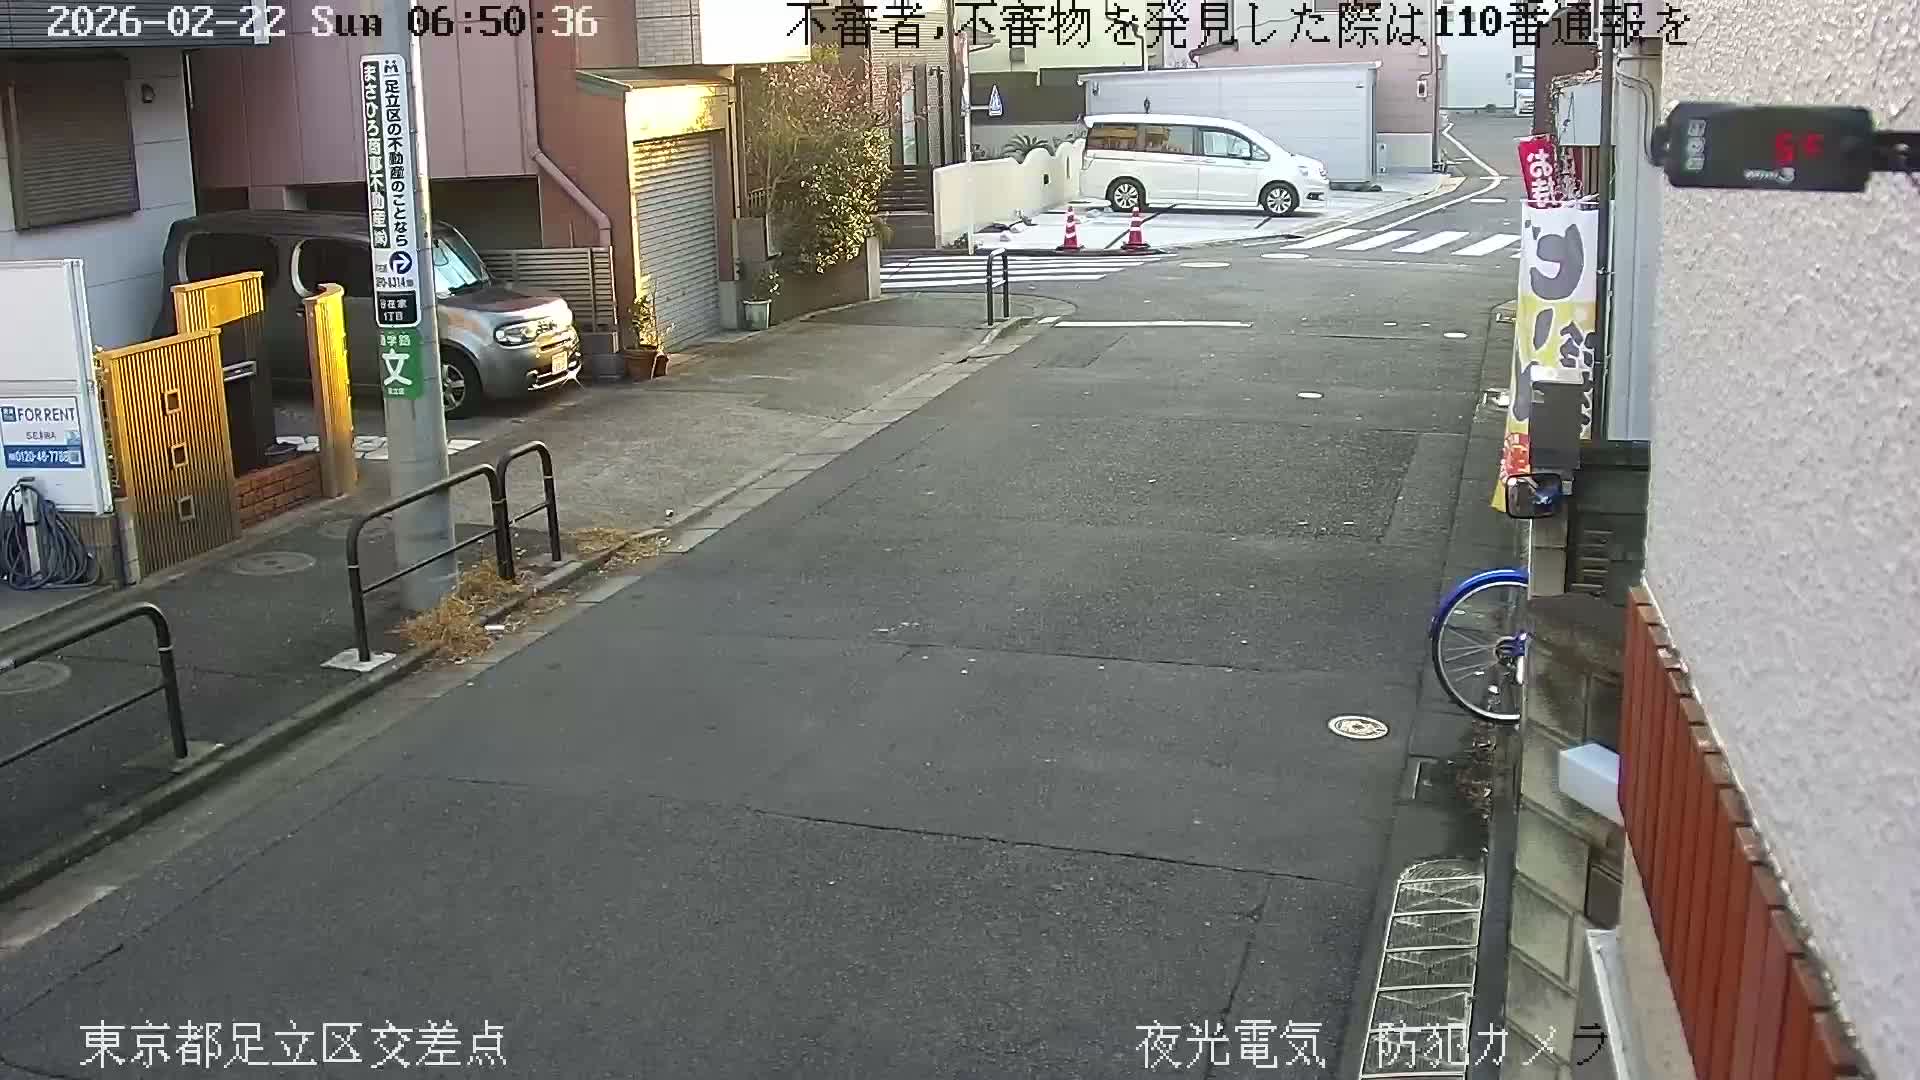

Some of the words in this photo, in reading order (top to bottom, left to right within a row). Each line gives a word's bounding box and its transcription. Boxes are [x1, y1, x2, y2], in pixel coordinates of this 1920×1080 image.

[385, 80, 408, 247] 足立区の不動産のことなら
[381, 348, 412, 386] 文
[17, 407, 41, 421] FOR
[44, 407, 75, 421] RENT
